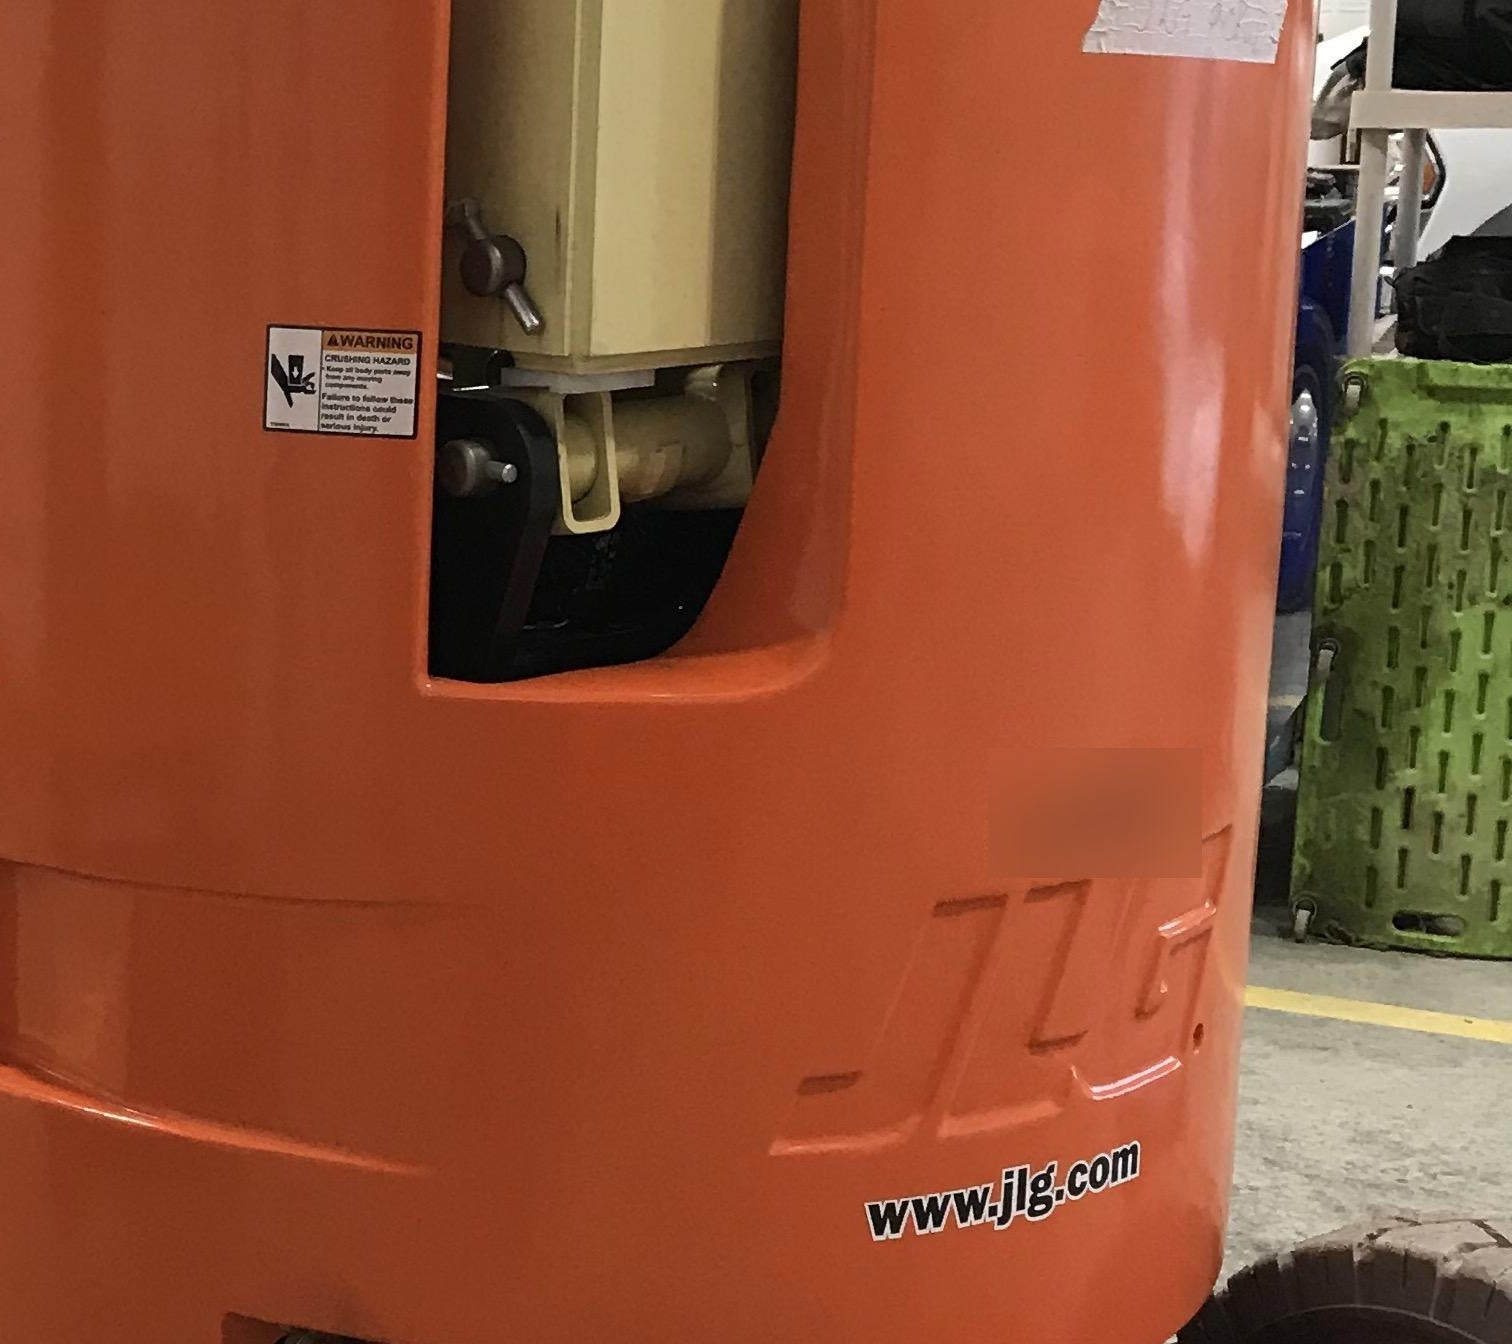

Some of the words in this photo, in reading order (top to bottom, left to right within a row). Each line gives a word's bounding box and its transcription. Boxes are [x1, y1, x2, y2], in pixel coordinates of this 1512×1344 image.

[338, 335, 413, 350] WARNING
[325, 355, 371, 364] CRUSHING
[373, 357, 411, 366] HAZARD
[326, 366, 344, 374] Keep
[355, 367, 373, 376] body
[322, 392, 350, 402] Failure
[362, 395, 388, 403] follow
[321, 413, 345, 421] result
[346, 413, 355, 421] in
[356, 414, 380, 423] death
[320, 423, 351, 431] serious
[865, 1140, 1142, 1242] www.jlg.com
